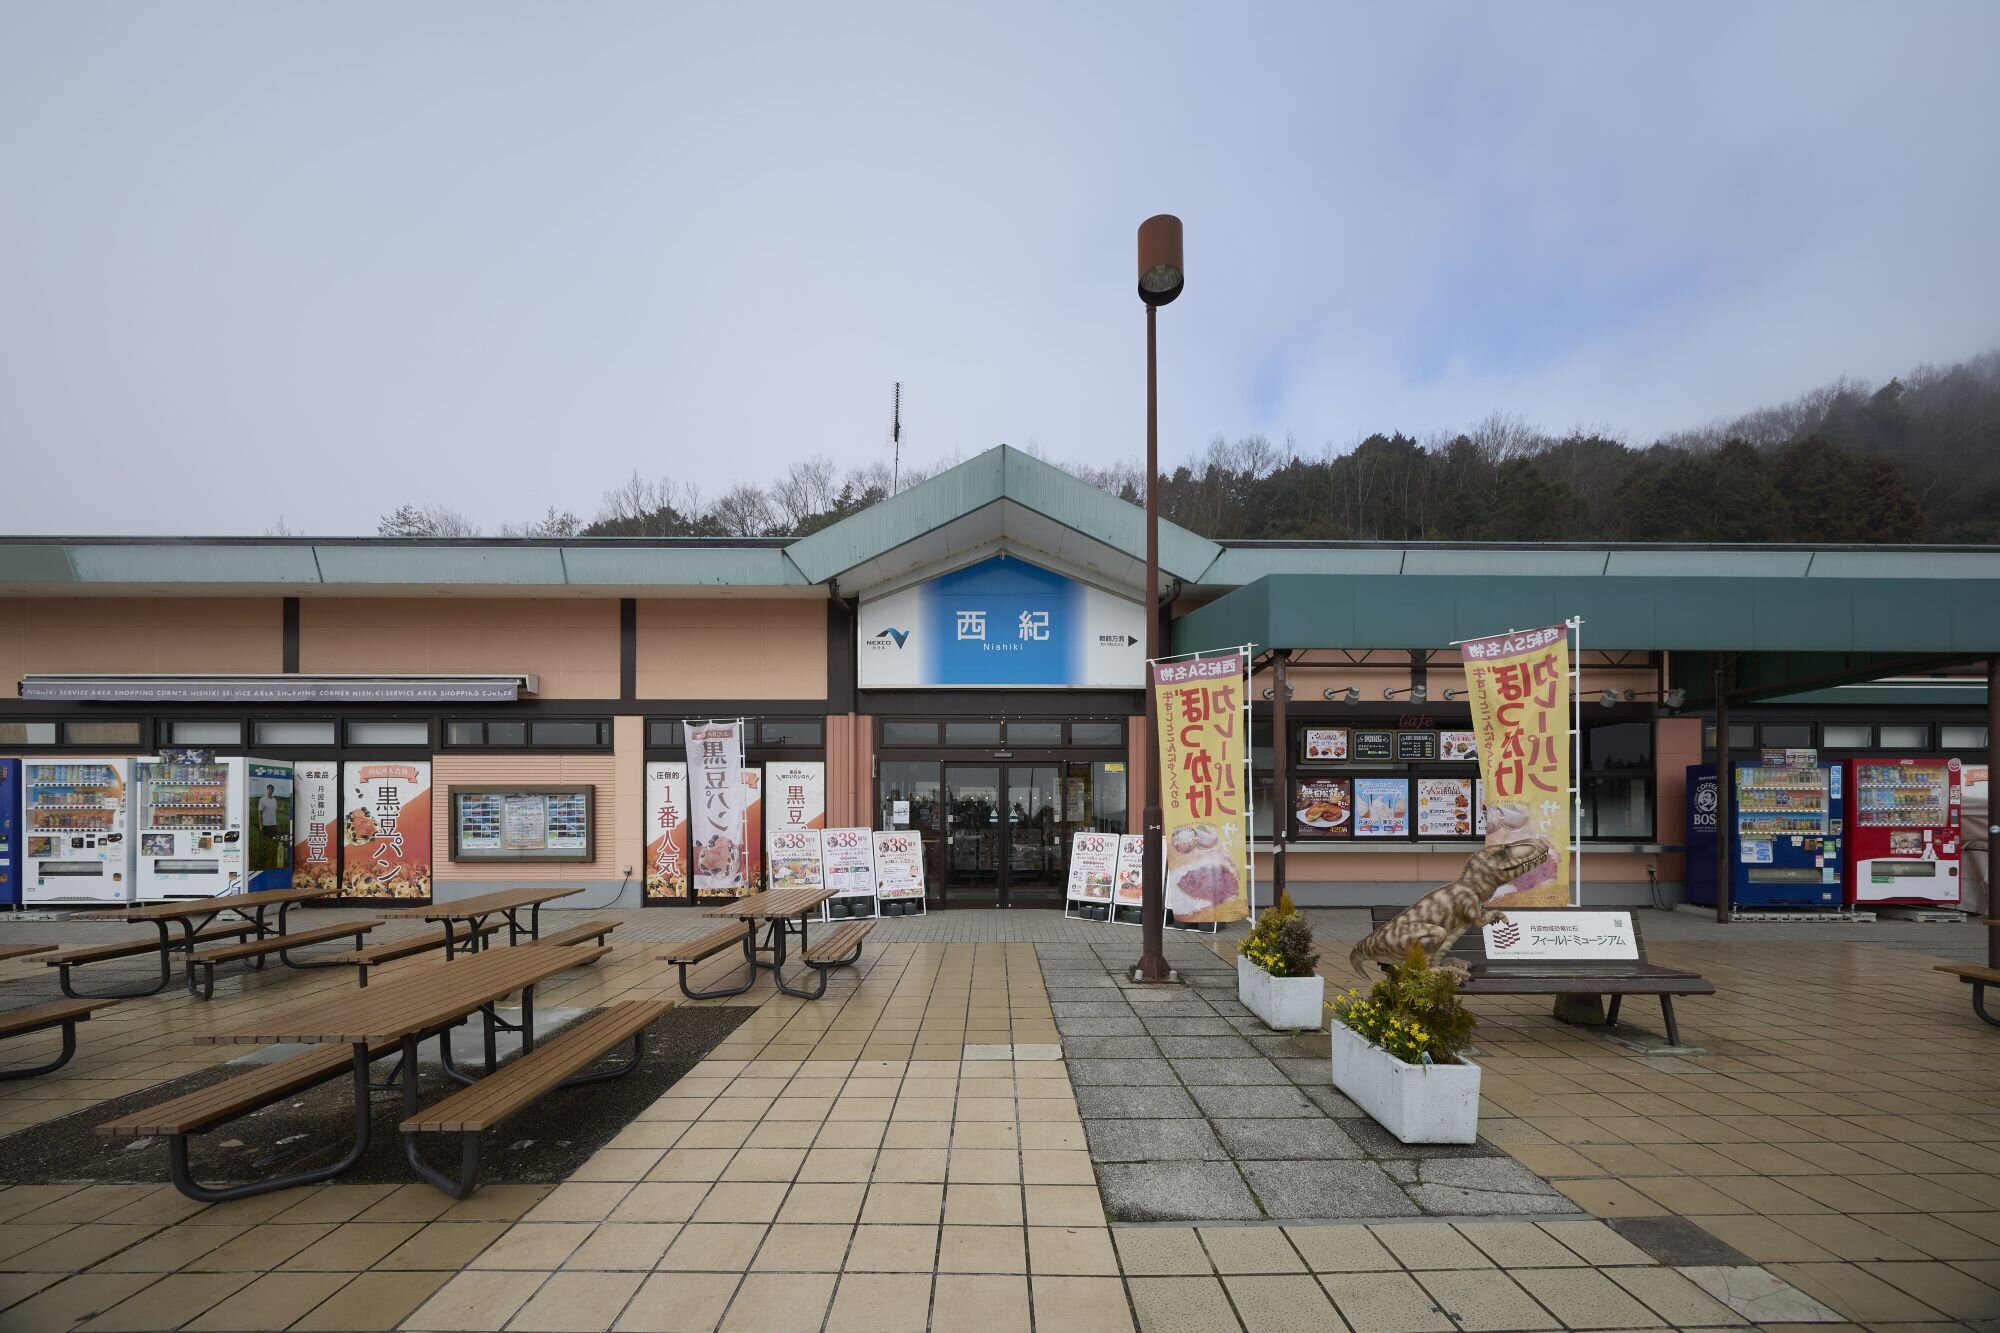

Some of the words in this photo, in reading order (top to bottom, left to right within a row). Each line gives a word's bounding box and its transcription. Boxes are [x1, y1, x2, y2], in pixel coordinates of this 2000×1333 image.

[956, 610, 1050, 641] 西紀
[983, 643, 1024, 651] Nishiki
[58, 689, 89, 697] SERVICE
[91, 689, 111, 697] AREA
[114, 689, 154, 697] SHOPPING
[319, 689, 350, 697] CORNER
[386, 689, 415, 697] SERVICE
[417, 689, 437, 697] AREA
[440, 689, 480, 697] SHOPPING
[1398, 713, 1433, 729] Cafe
[305, 771, 329, 779] 名産品
[656, 771, 680, 780] 圧倒的
[317, 785, 325, 817] 丹波篠山
[1693, 813, 1716, 825] BOS
[373, 786, 403, 881] 黒豆パン
[656, 785, 681, 876] 1番人気
[307, 822, 328, 863] 黒豆
[1531, 934, 1627, 946] フィールドミュージアム
